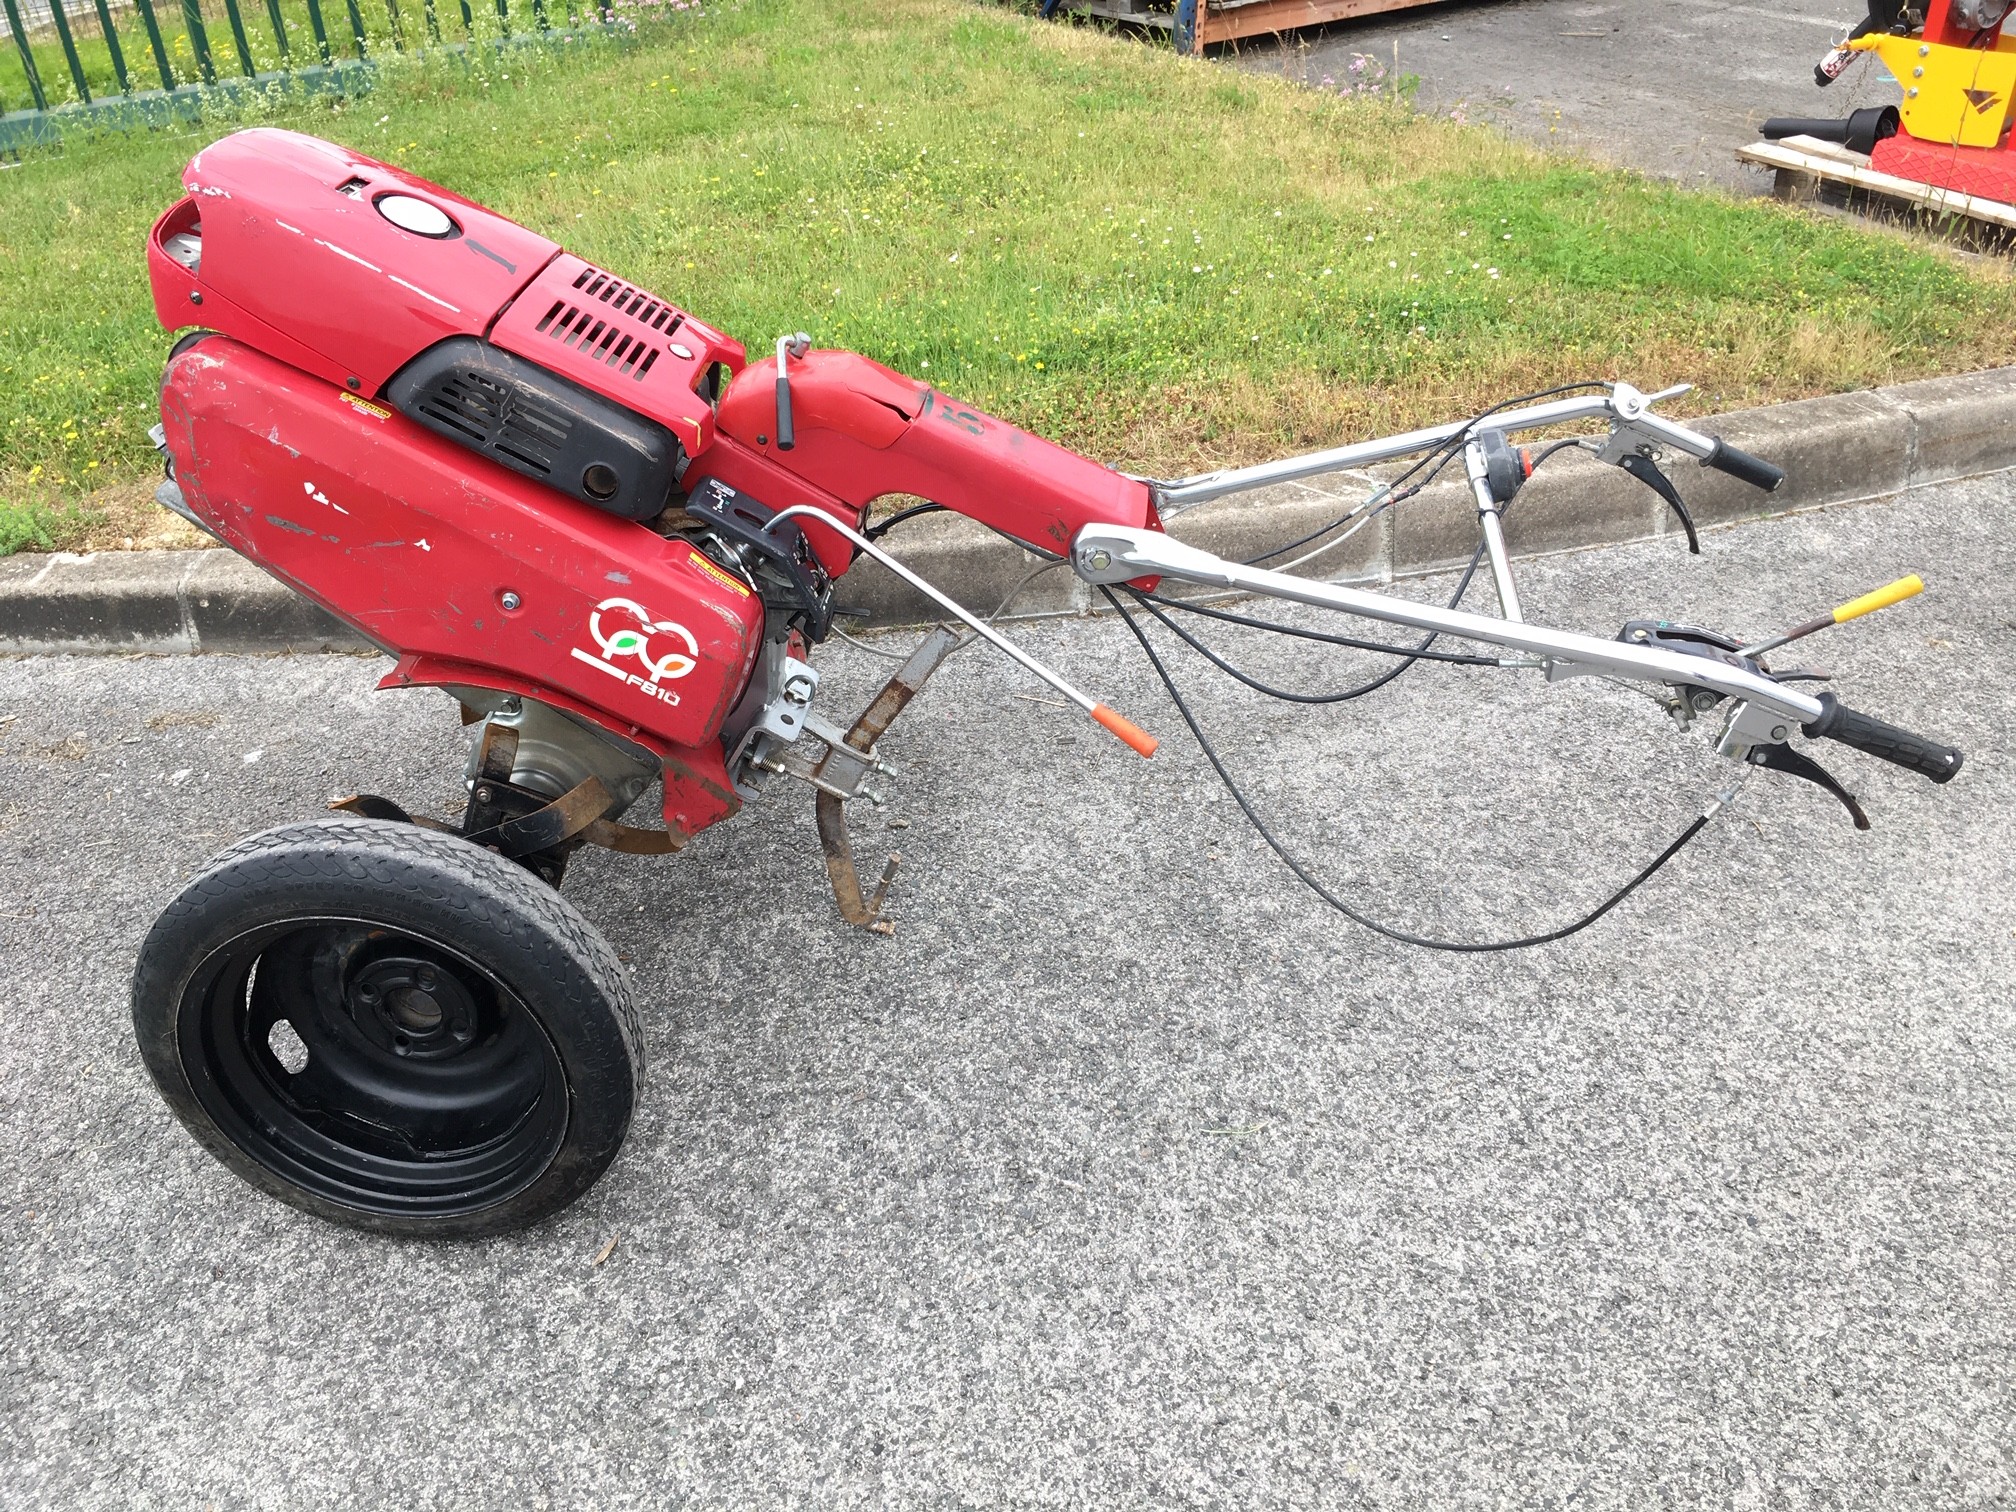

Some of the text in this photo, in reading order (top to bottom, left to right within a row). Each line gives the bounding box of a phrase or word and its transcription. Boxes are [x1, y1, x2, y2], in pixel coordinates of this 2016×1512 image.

[352, 397, 390, 417] ATTENTION
[707, 566, 741, 590] ATTENTION
[626, 674, 681, 707] F810
